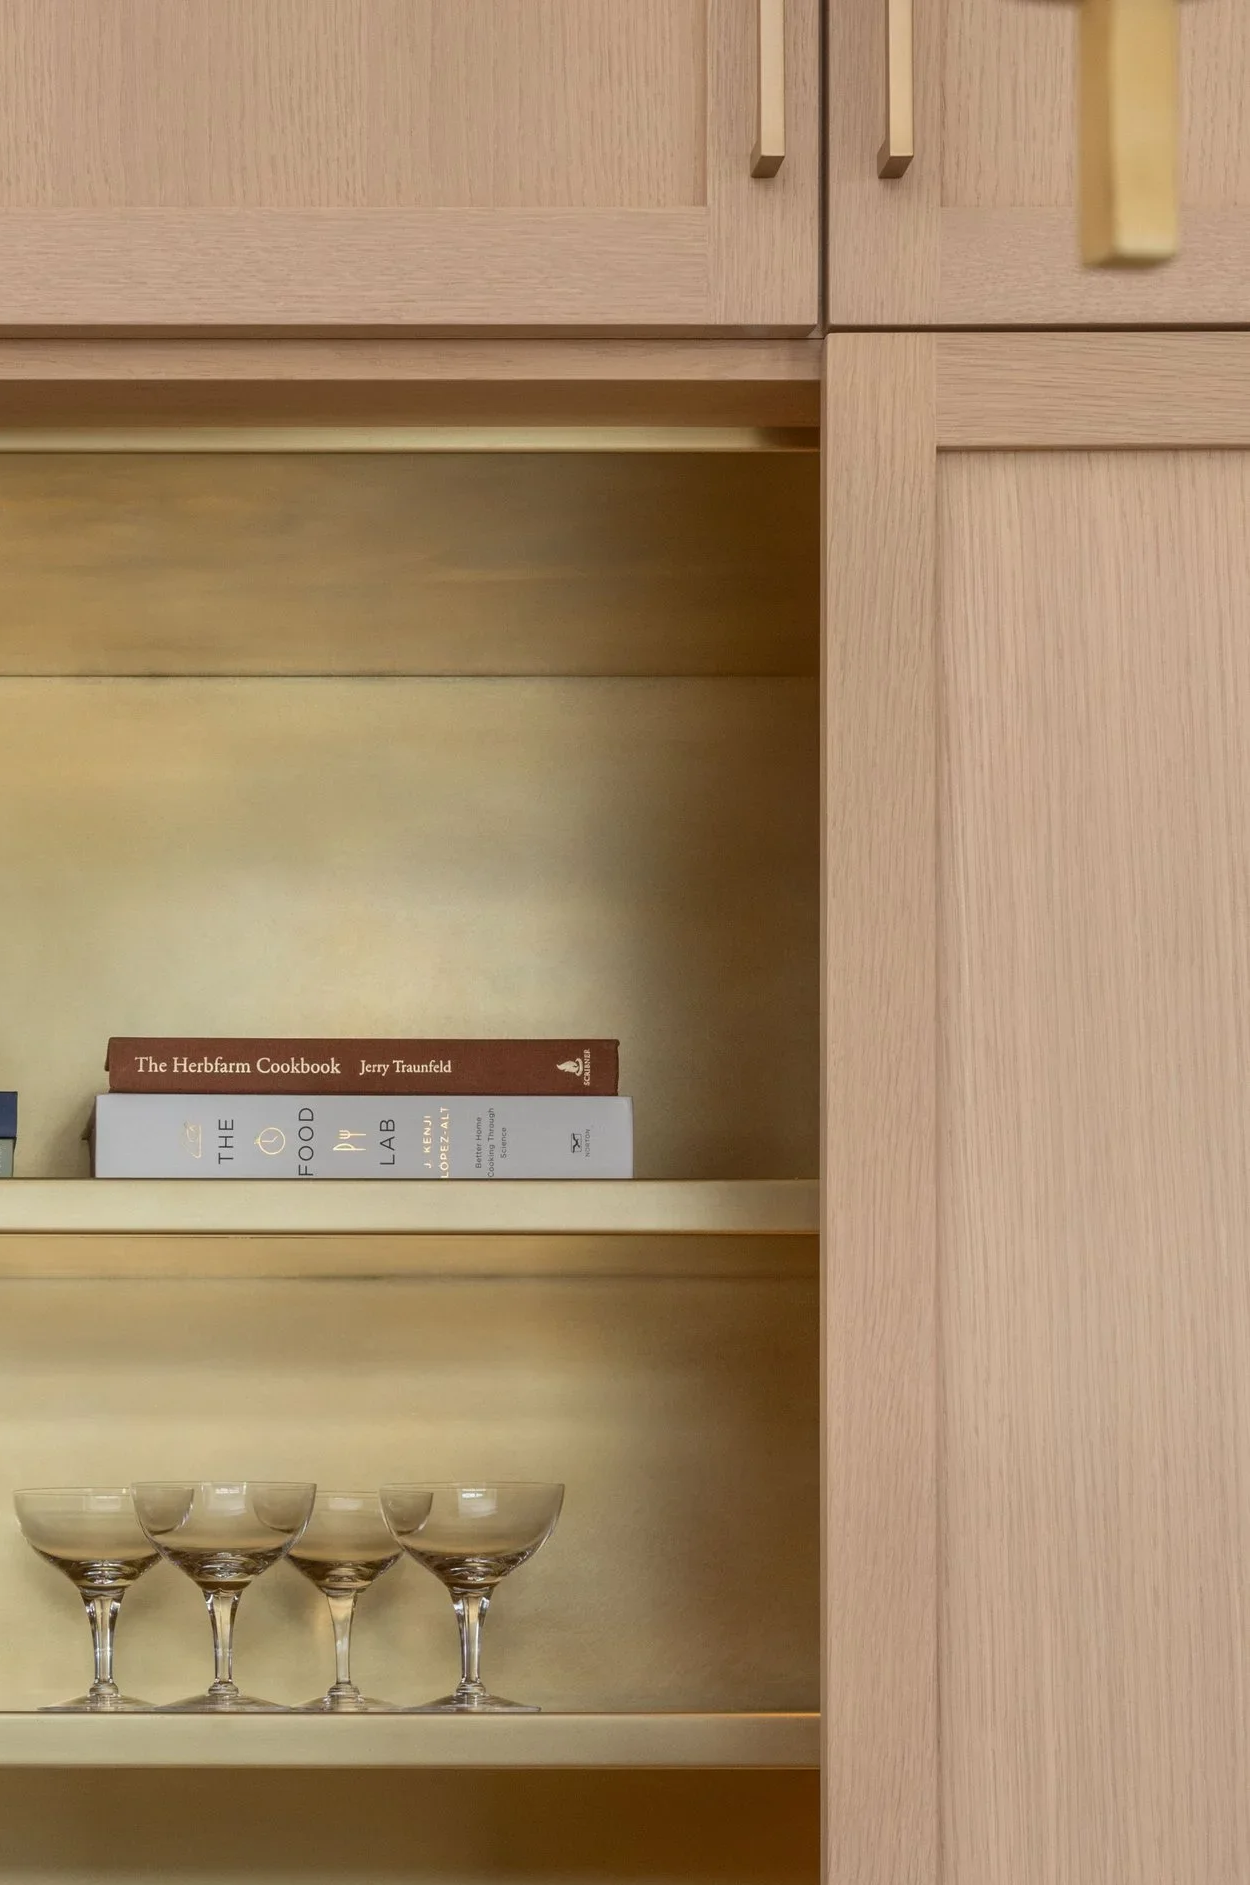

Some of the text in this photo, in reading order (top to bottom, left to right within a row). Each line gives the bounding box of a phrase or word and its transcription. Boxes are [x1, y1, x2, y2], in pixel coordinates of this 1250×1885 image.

[134, 1056, 341, 1075] The Herbfarm Cookbook
[359, 1059, 452, 1077] Jerry Traunfeld
[583, 1048, 591, 1087] SCRIBNER
[218, 1119, 234, 1165] THE
[298, 1107, 314, 1176] FOOD
[379, 1119, 395, 1165] LAB
[423, 1115, 432, 1154] KENJI
[475, 1116, 483, 1169] Better Home
[487, 1107, 496, 1178] Cooking Through
